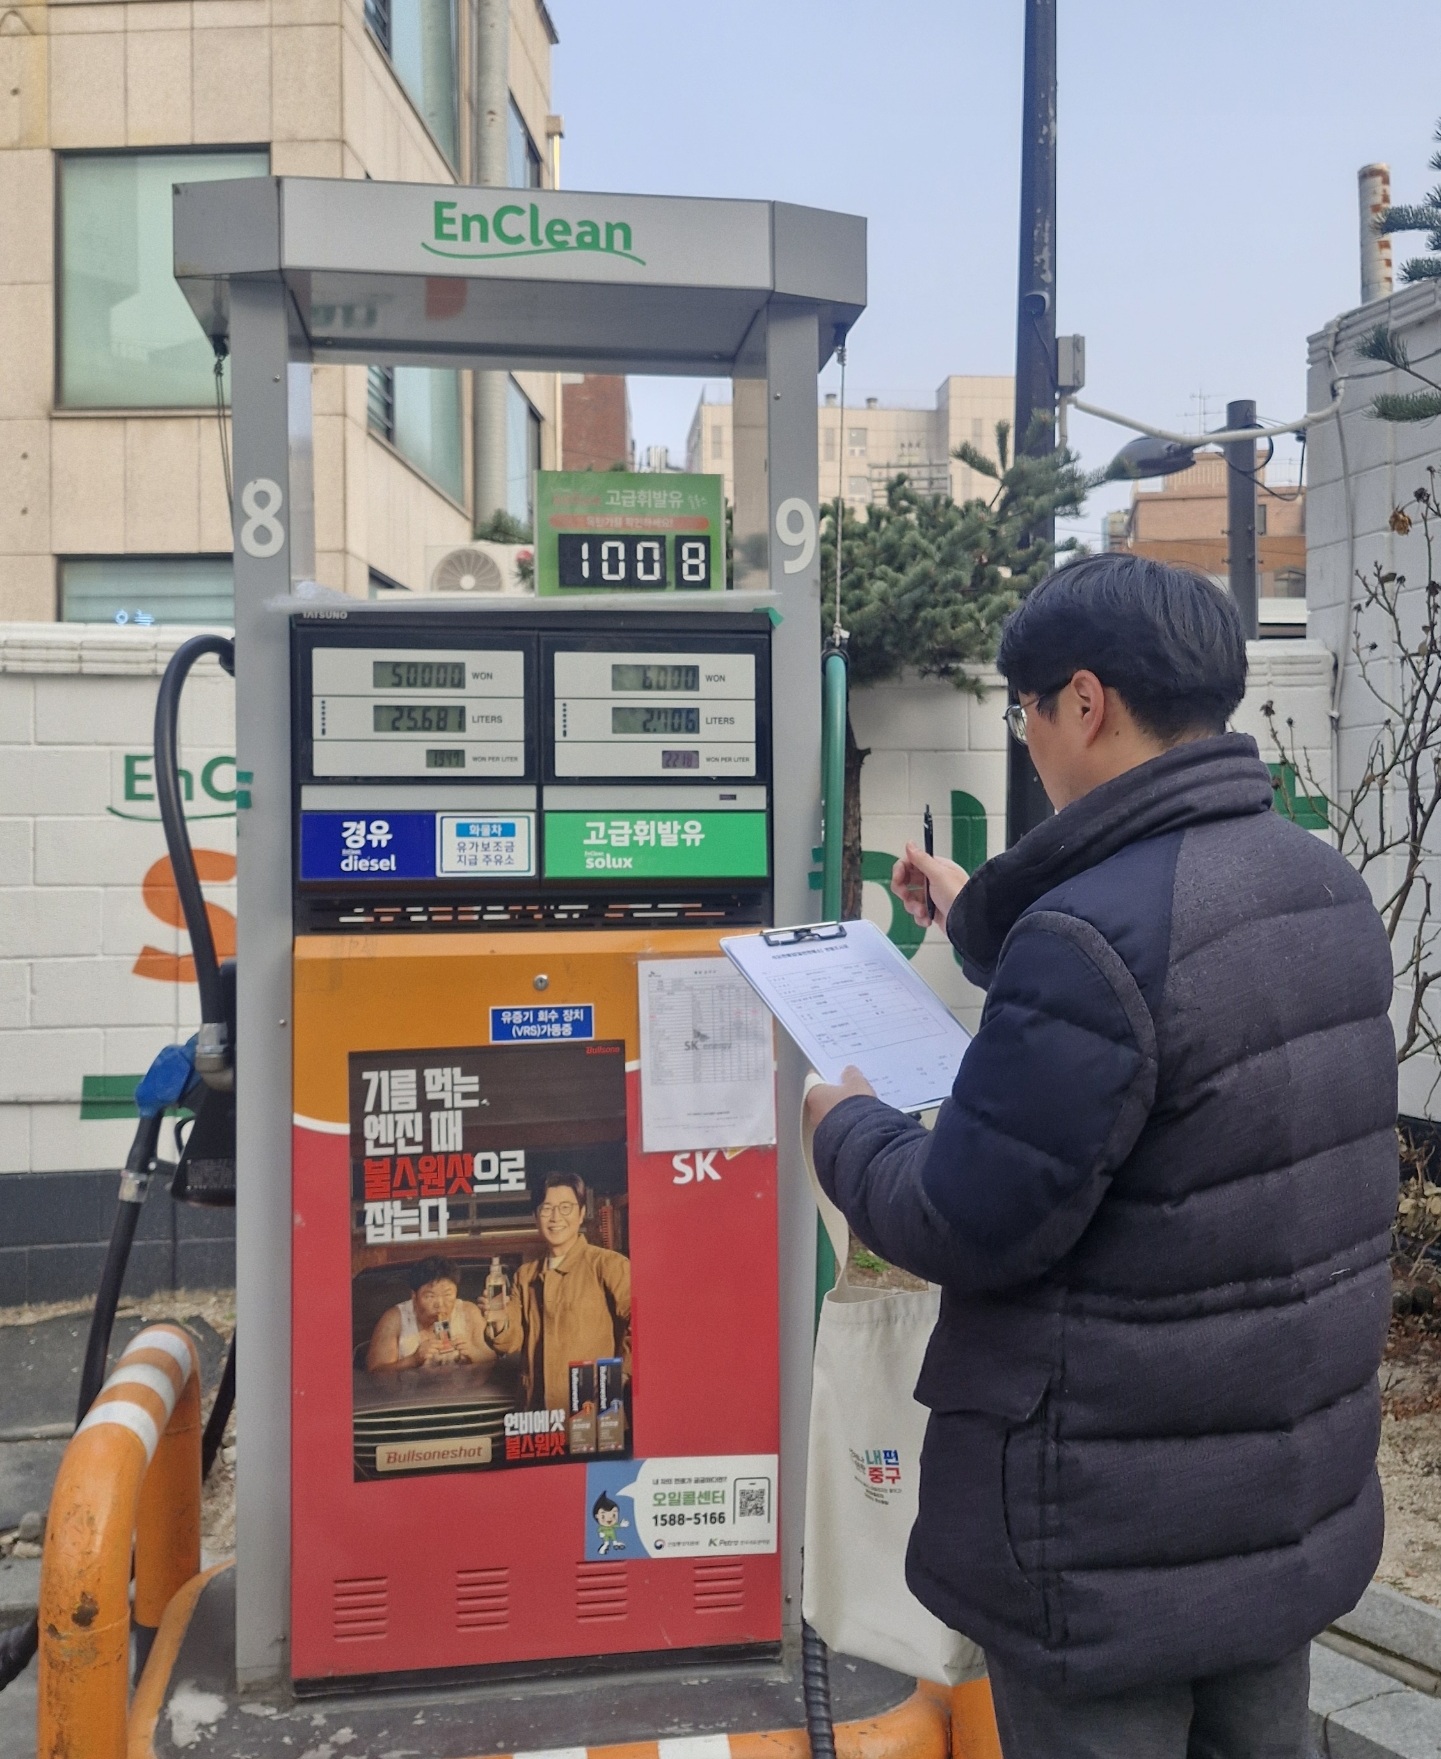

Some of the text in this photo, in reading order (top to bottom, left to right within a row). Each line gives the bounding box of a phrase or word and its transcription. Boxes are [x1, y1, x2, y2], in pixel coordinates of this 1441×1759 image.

[434, 201, 632, 250] EnClean
[604, 488, 684, 509] 고급휘발유
[241, 478, 285, 558] 8
[776, 497, 816, 574] 9
[391, 664, 463, 688] 50000
[471, 672, 493, 680] WON
[705, 674, 726, 682] WON
[471, 715, 503, 723] LITERS
[705, 716, 735, 725] LITERS
[341, 820, 393, 849] 경유
[468, 824, 502, 837] 화물차
[583, 820, 705, 847] 고급휘발유
[456, 841, 515, 853] 유가보조금
[340, 854, 397, 872] diesel
[456, 854, 515, 866] 지급 주유소
[585, 854, 633, 869] solux
[501, 1008, 584, 1024] 유증기 회수 장치
[511, 1024, 573, 1038] (VRS)가동중
[585, 1046, 620, 1055] Bullsone
[684, 1041, 699, 1051] SK
[362, 1067, 480, 1112] 기름 먹는
[363, 1110, 463, 1156] 엔진 때
[363, 1149, 527, 1200] 불스원샷으로
[672, 1149, 722, 1185] SK
[364, 1198, 449, 1245] 잡는다
[506, 1431, 566, 1461] 불스원샷
[386, 1445, 483, 1465] Bullsoneshot
[865, 1449, 900, 1466] 내편
[868, 1467, 901, 1484] 중구
[652, 1490, 726, 1507] 오일콜센터
[652, 1511, 726, 1527] 1588-5166
